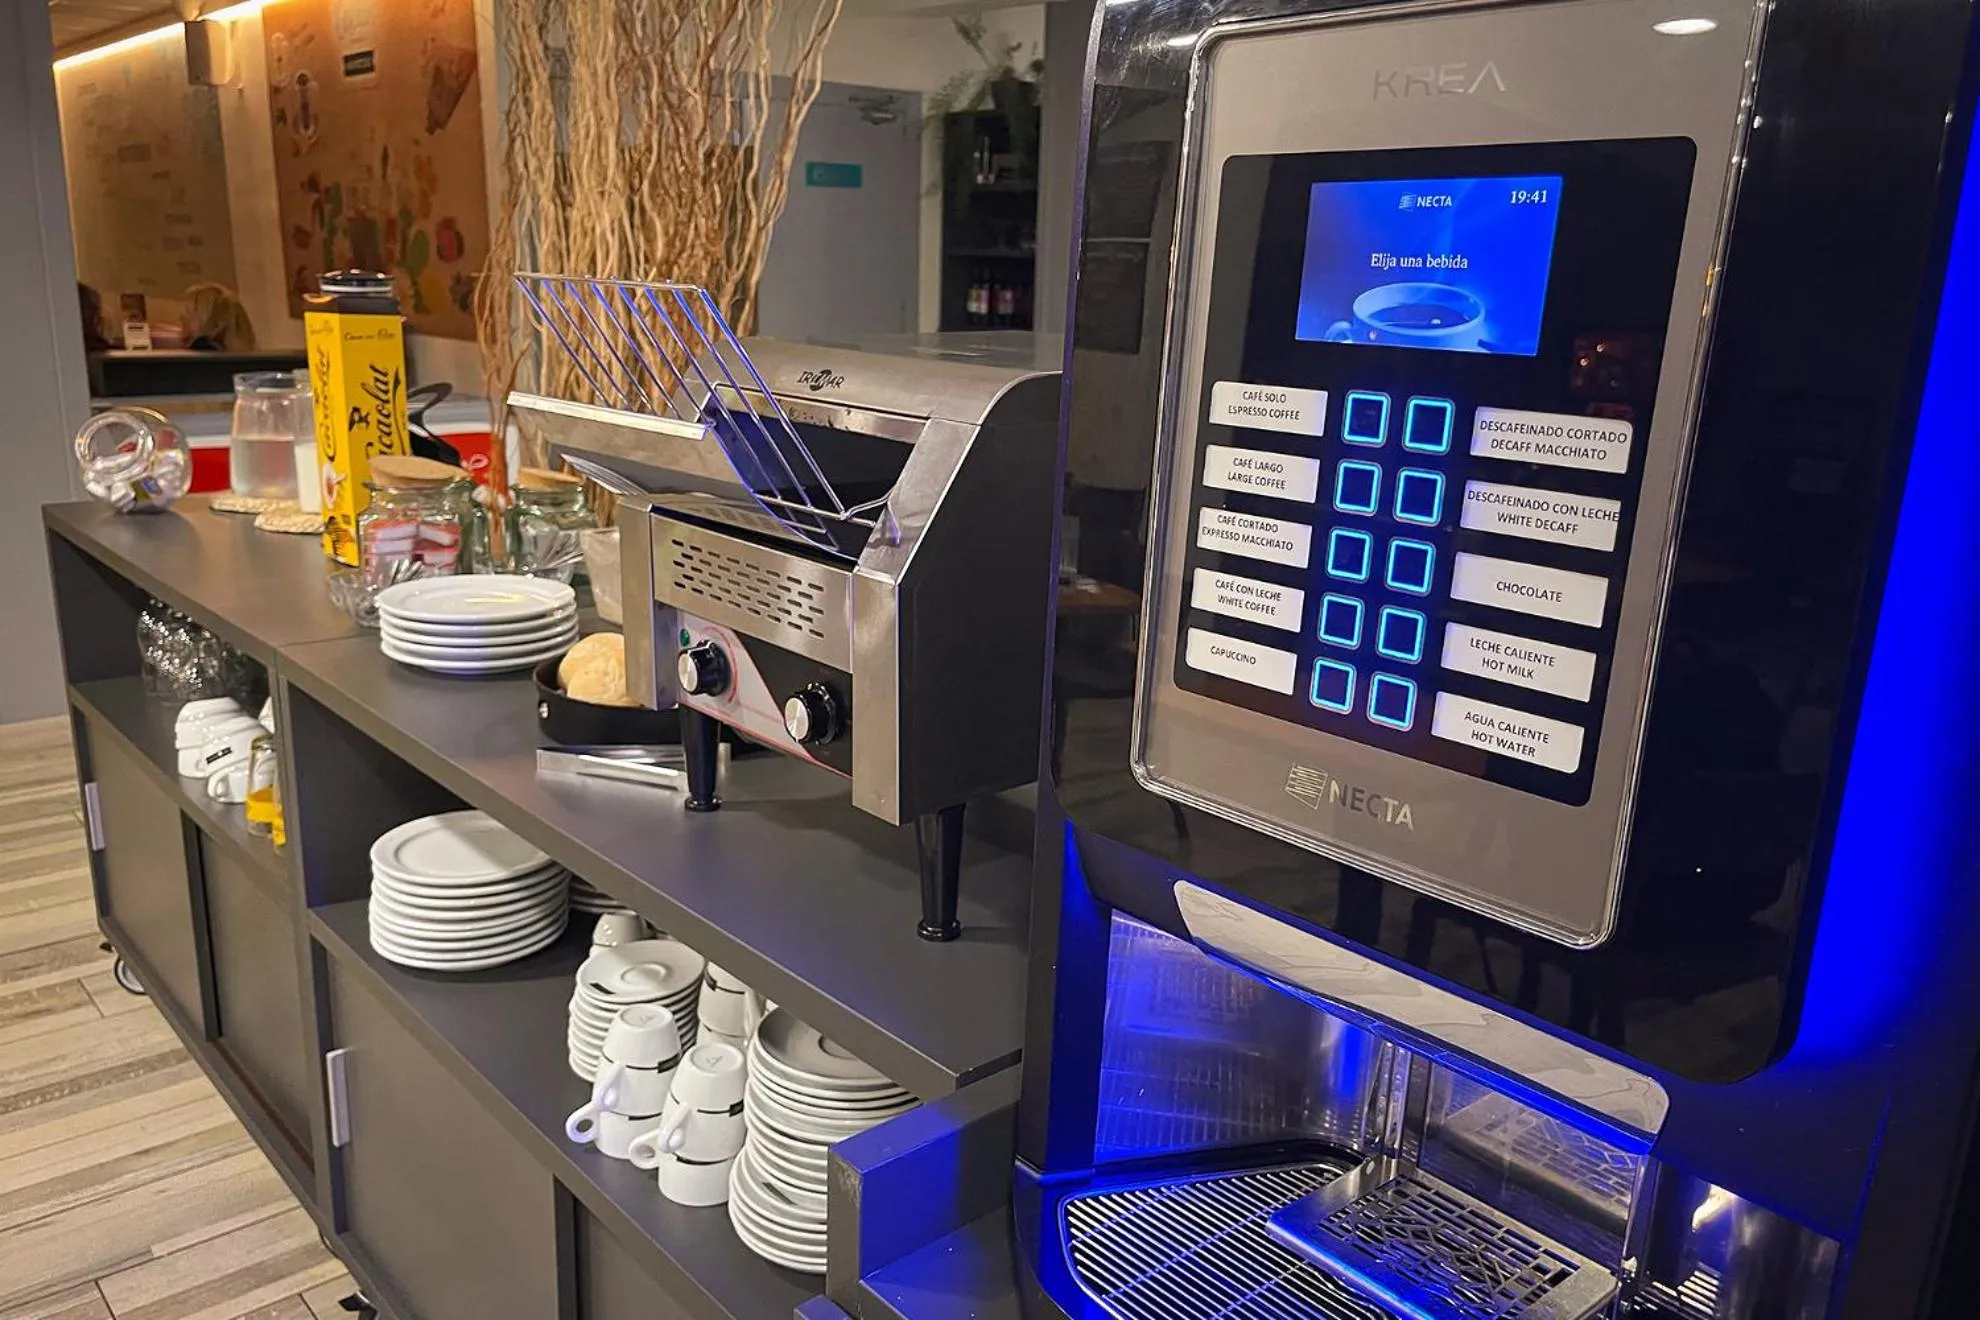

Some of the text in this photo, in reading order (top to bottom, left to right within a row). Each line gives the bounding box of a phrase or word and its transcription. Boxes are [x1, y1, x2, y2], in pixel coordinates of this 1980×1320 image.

[1373, 61, 1505, 100] KREA
[1416, 195, 1453, 208] NECTA
[1509, 190, 1548, 205] 19:41
[1370, 253, 1469, 271] Elija una bebida
[1242, 389, 1287, 404] CAFÉ SOLO
[1228, 404, 1300, 421] ESPRESSO COFFEE
[1479, 420, 1628, 444] DESCAFEINADO CORTADO
[1490, 438, 1607, 461] DECAFF MACCHIATO
[1233, 457, 1284, 474] CAFÉ LARGO
[1227, 471, 1287, 490] LARGE COFFEE
[1467, 490, 1620, 522] DESCAFEINADO CON LECHE
[1217, 513, 1279, 533] CAFÉ CORTADO
[1497, 511, 1579, 535] WHITE DECAFF
[1201, 526, 1294, 551] EXPRESSO MACCHIATO
[1215, 579, 1282, 601] CAFÉ CON LECHE
[1496, 580, 1564, 603] CHOCOLATE
[1217, 594, 1276, 616] WHITE COFFEE
[1210, 646, 1257, 665] CAPUCCINO
[1470, 637, 1556, 668] LECHE CALIENTE
[1481, 656, 1535, 680] HOT MILK
[1464, 711, 1550, 744] AGUA CALIENTE
[1471, 729, 1536, 758] HOT WATER
[1329, 779, 1415, 832] NECTA
